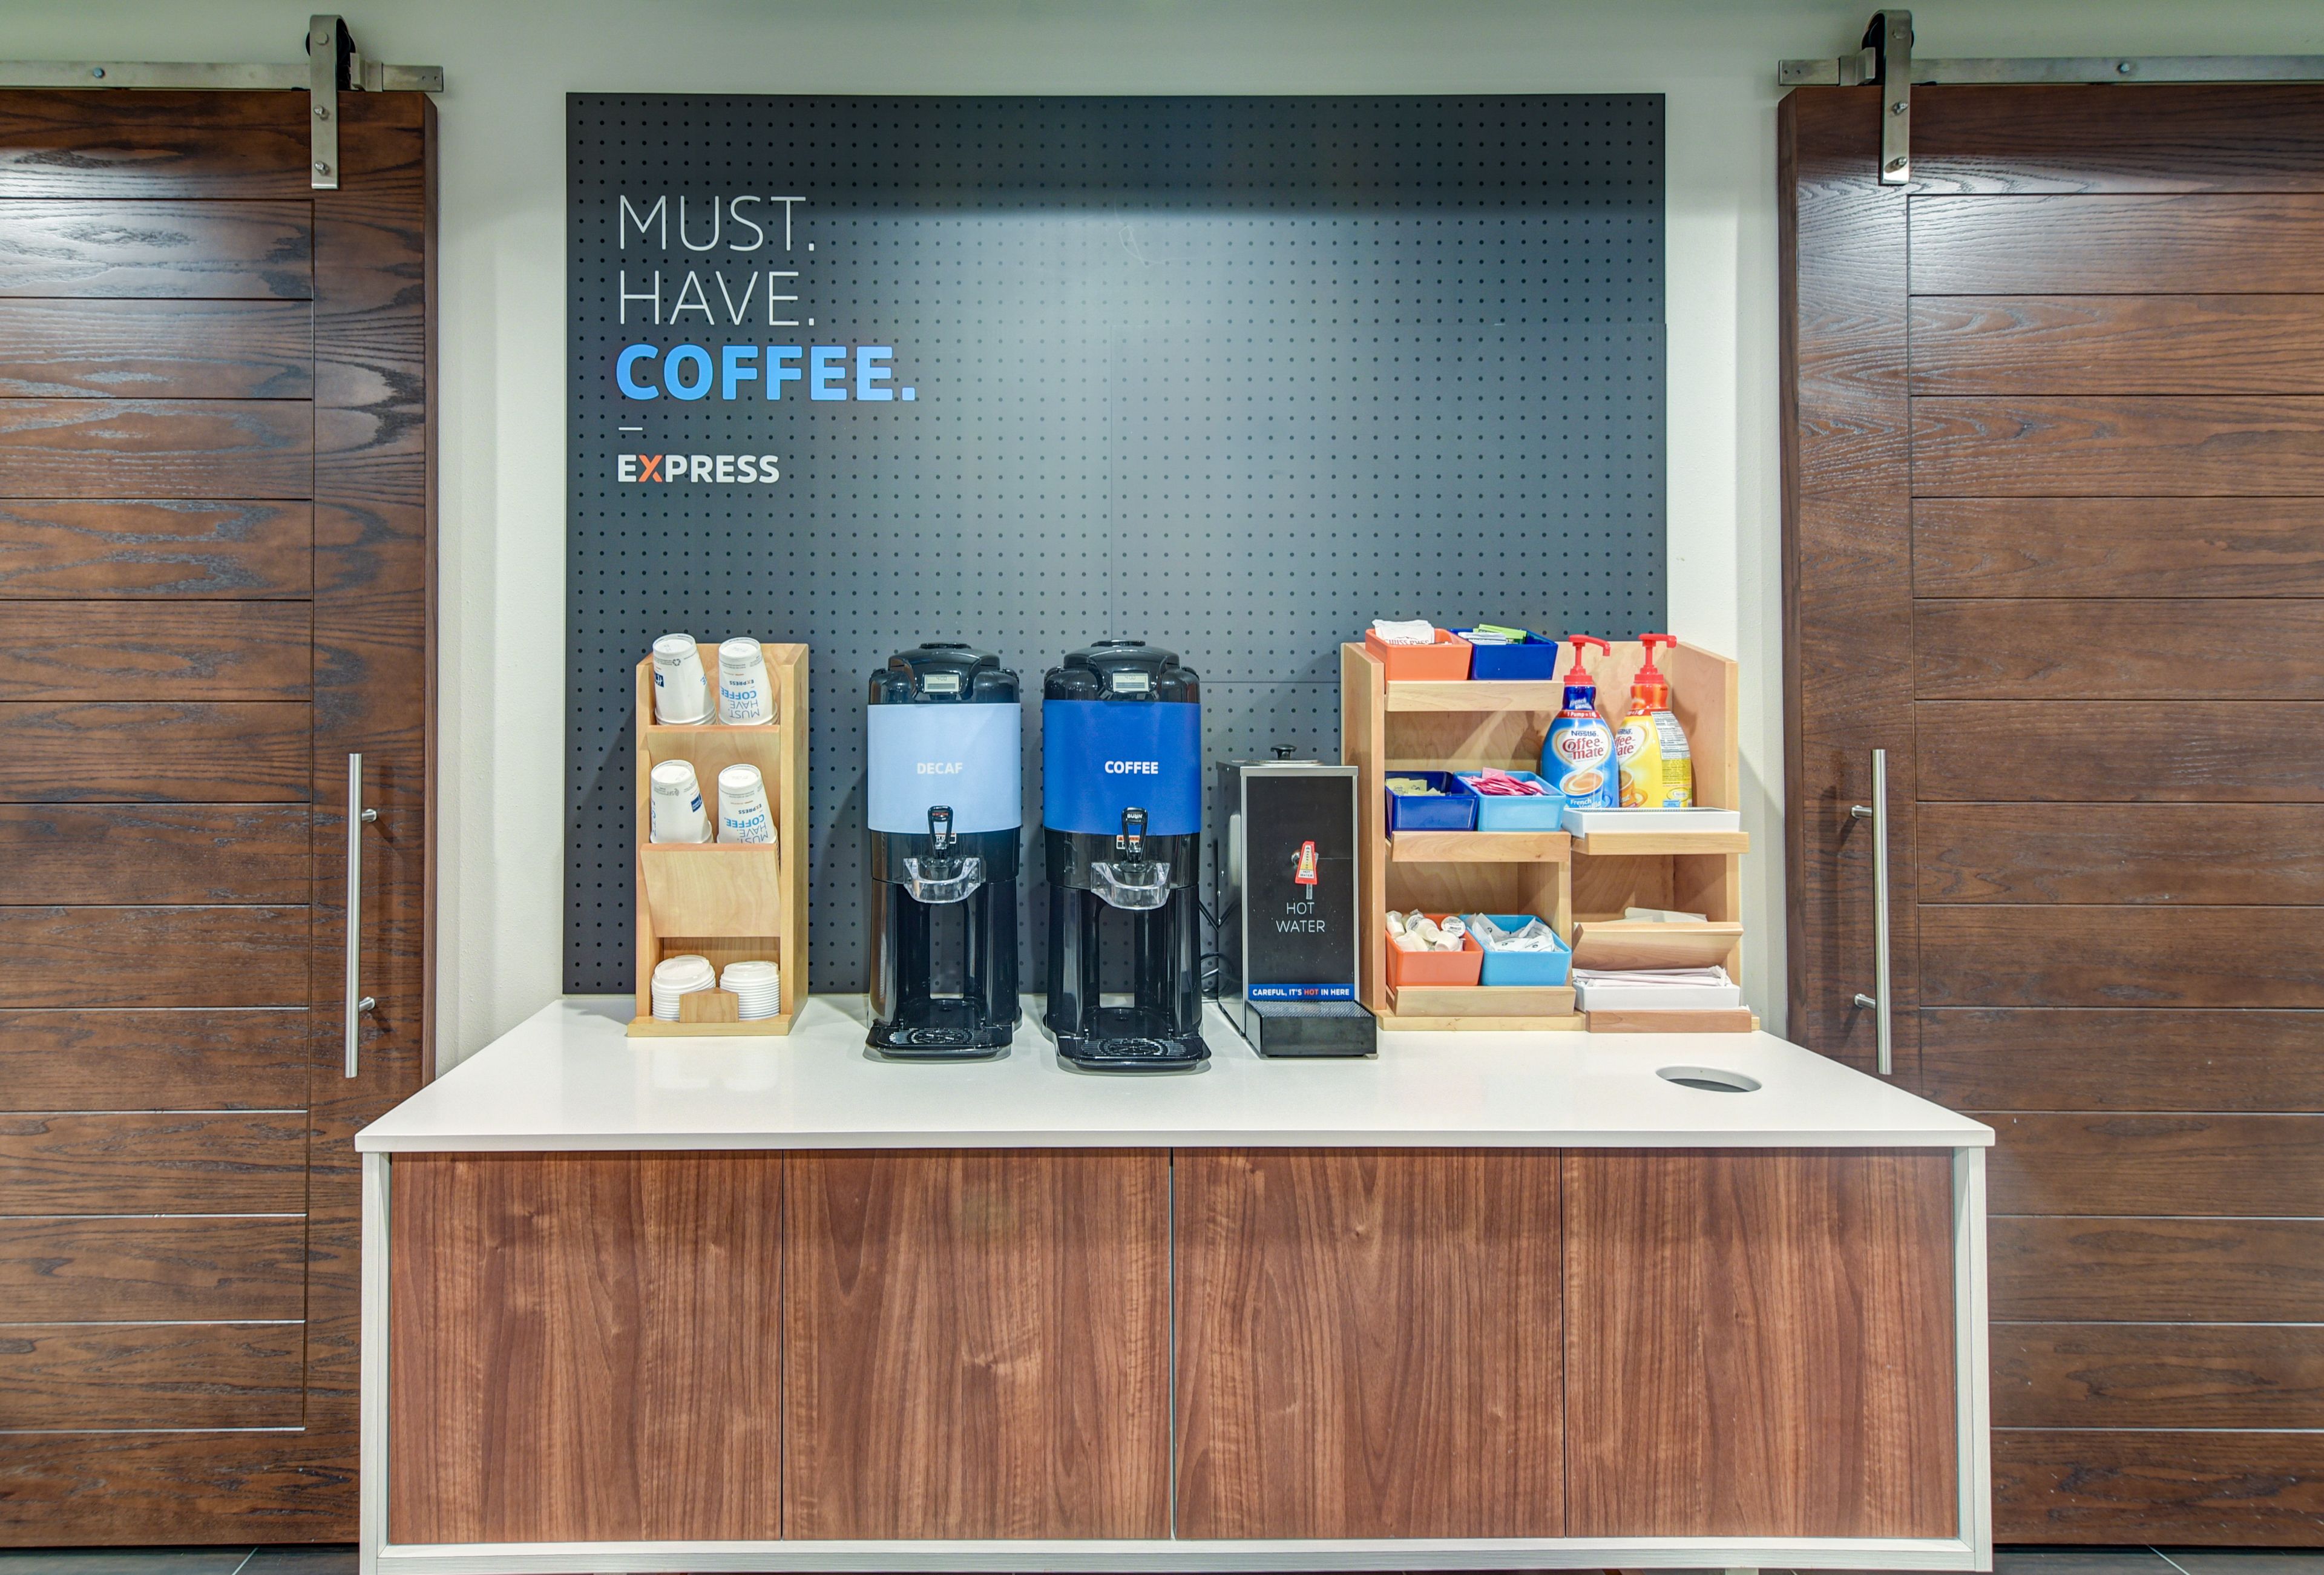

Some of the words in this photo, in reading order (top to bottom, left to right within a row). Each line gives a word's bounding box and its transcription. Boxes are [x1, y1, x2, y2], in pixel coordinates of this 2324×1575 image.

[620, 194, 815, 252] MUST.
[620, 270, 815, 326] HAVE.
[615, 344, 916, 401] COFFEE.
[618, 454, 780, 484] EXPRESS
[728, 699, 759, 709] HAVE.
[728, 708, 760, 718] MUST.
[1573, 746, 1604, 760] mate
[1617, 745, 1634, 756] ate
[917, 762, 963, 775] DECAF
[1105, 760, 1158, 775] COFFEE
[738, 803, 762, 814] EXPRESS
[724, 814, 765, 828] COFFEE.
[737, 822, 767, 837] HAVE.
[1286, 902, 1315, 915] HOT
[1276, 920, 1325, 933] WATER
